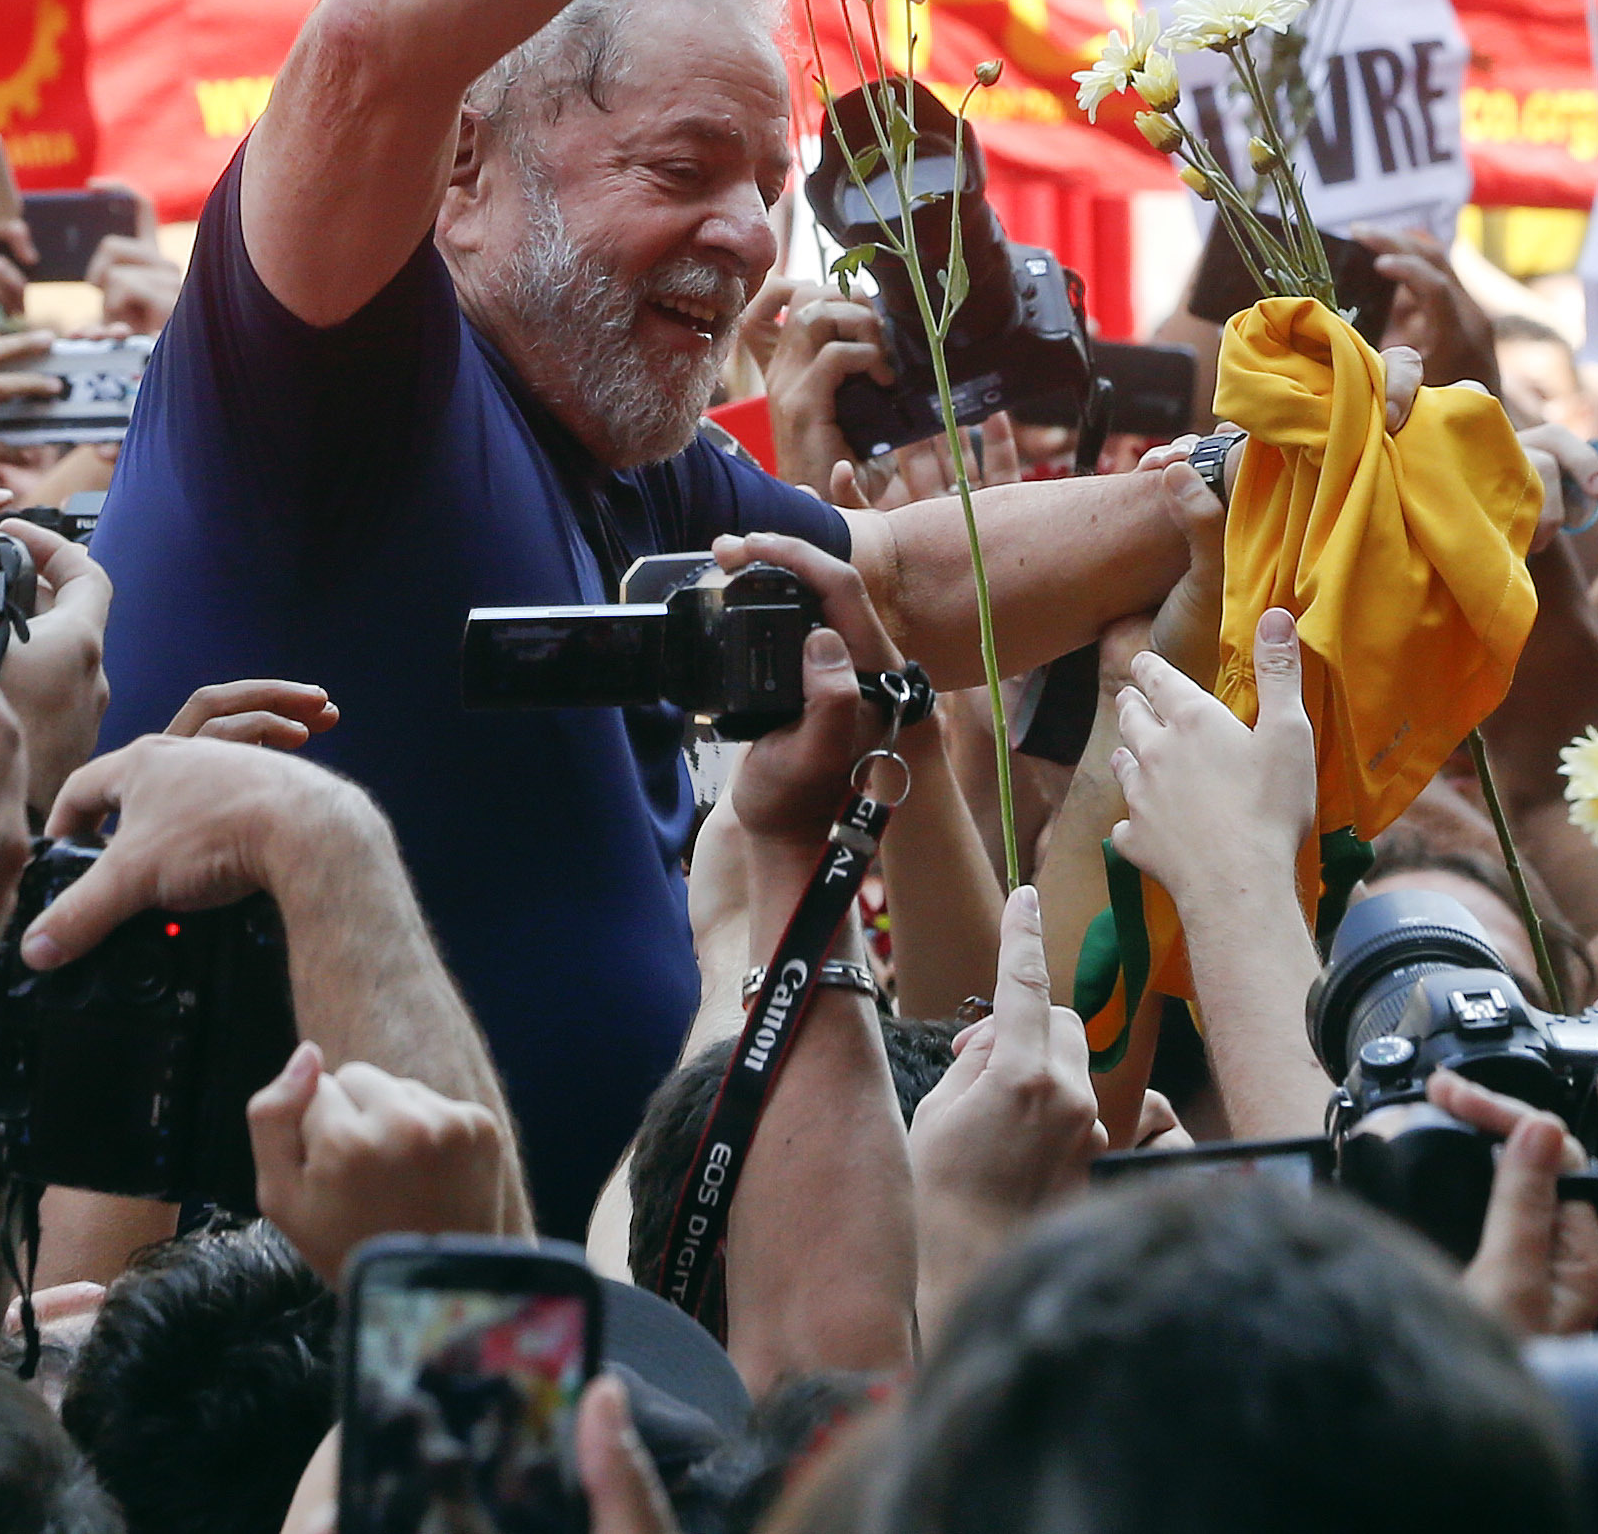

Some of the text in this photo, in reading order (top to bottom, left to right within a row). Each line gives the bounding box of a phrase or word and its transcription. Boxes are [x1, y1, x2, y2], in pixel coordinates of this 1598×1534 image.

[1192, 40, 1452, 187] LVRE
[669, 797, 878, 1308] GIAL Canon EOS DIGIT
